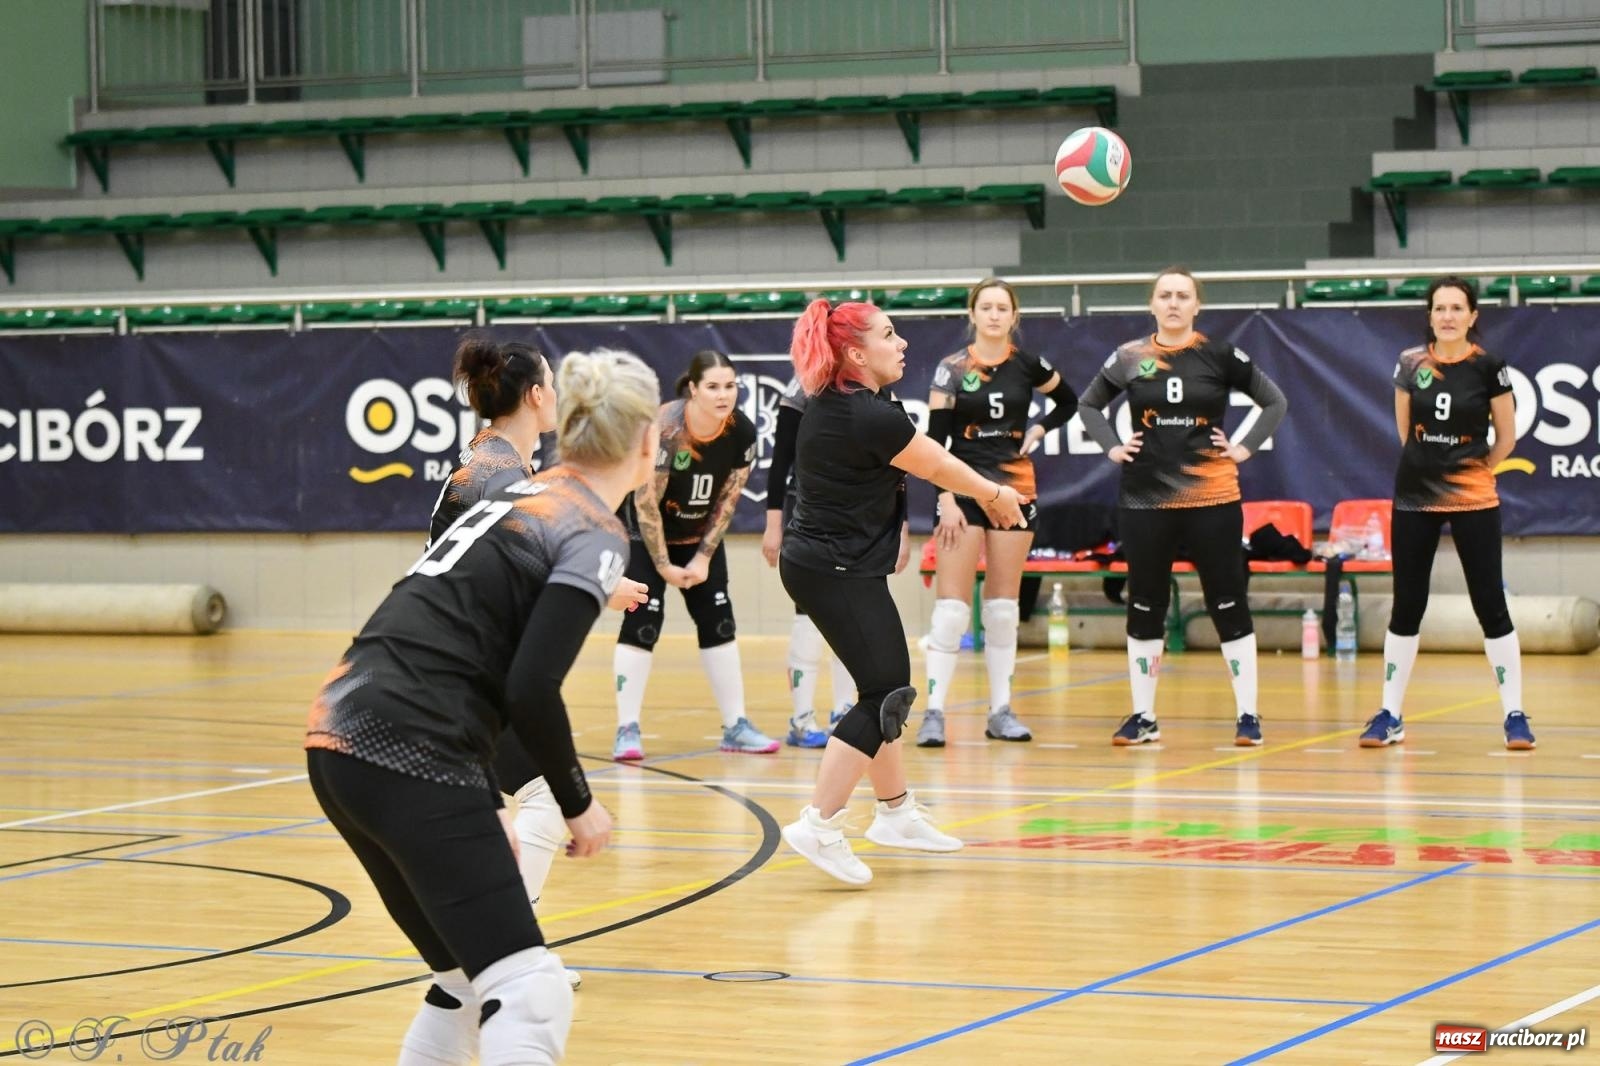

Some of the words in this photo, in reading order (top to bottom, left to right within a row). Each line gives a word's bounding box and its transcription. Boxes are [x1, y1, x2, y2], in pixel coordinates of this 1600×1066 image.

[1166, 377, 1184, 404] 8
[988, 392, 1005, 419] 5
[1435, 392, 1452, 421] 9
[691, 474, 713, 500] 10
